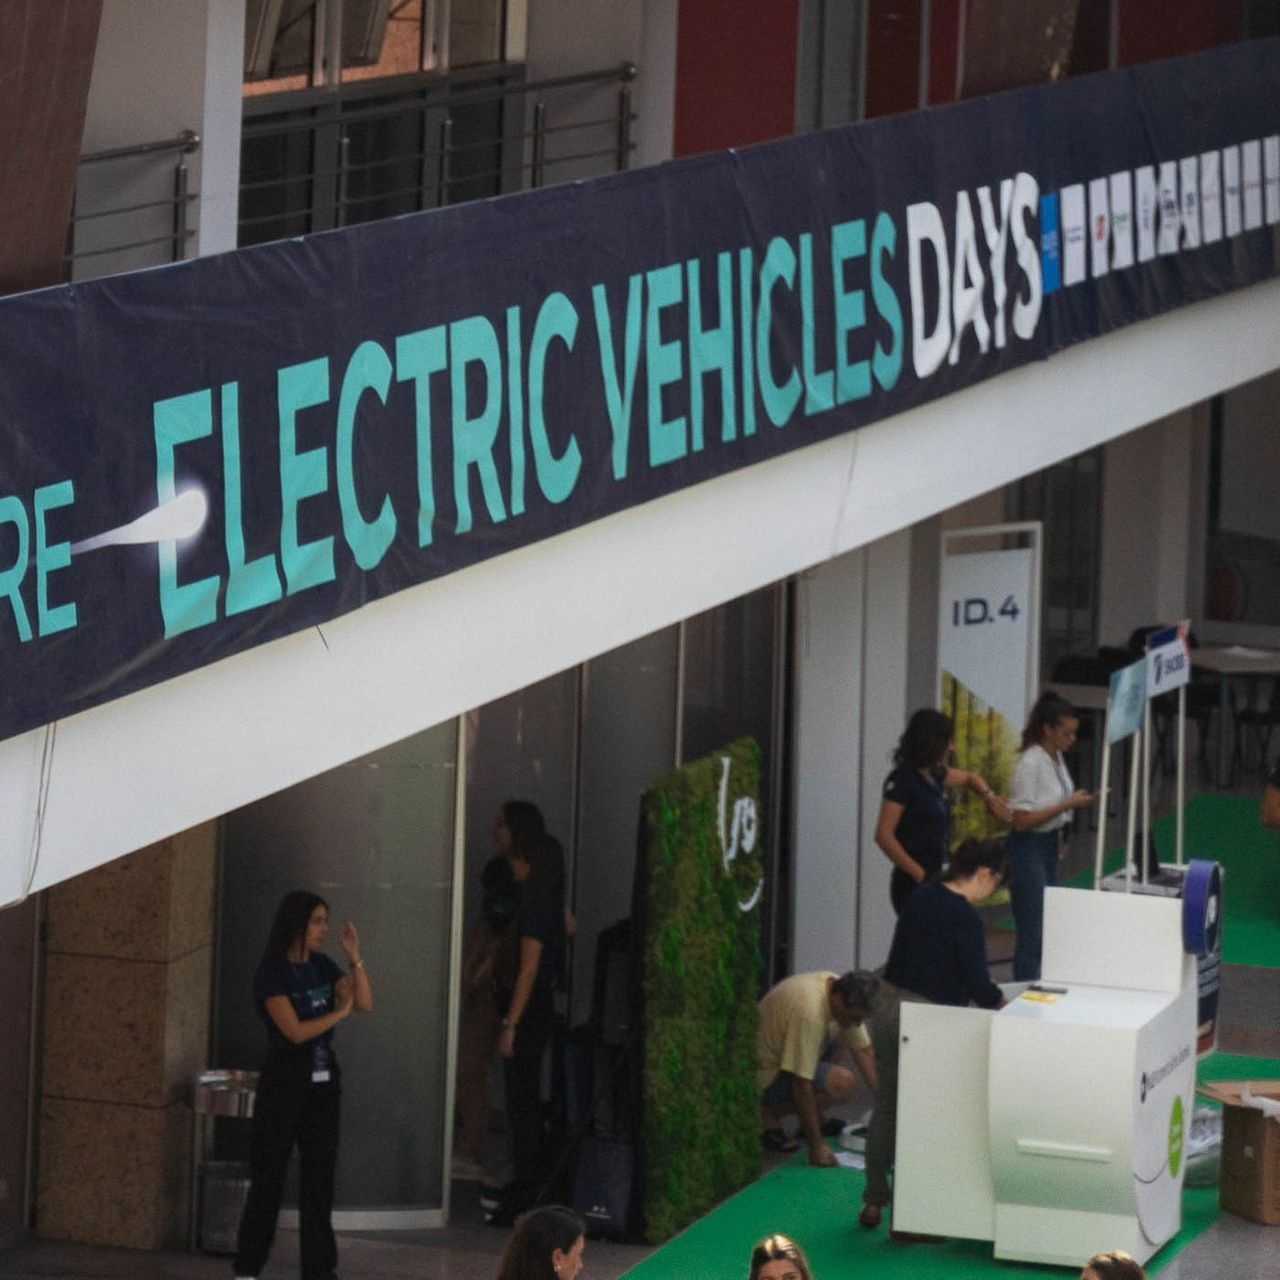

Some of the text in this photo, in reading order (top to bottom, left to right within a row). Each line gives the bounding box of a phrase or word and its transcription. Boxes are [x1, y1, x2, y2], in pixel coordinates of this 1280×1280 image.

[153, 292, 581, 640] ELECTRIC
[592, 213, 903, 479] VEHICLES
[907, 171, 1042, 378] DAYS
[952, 595, 1020, 627] ID.4
